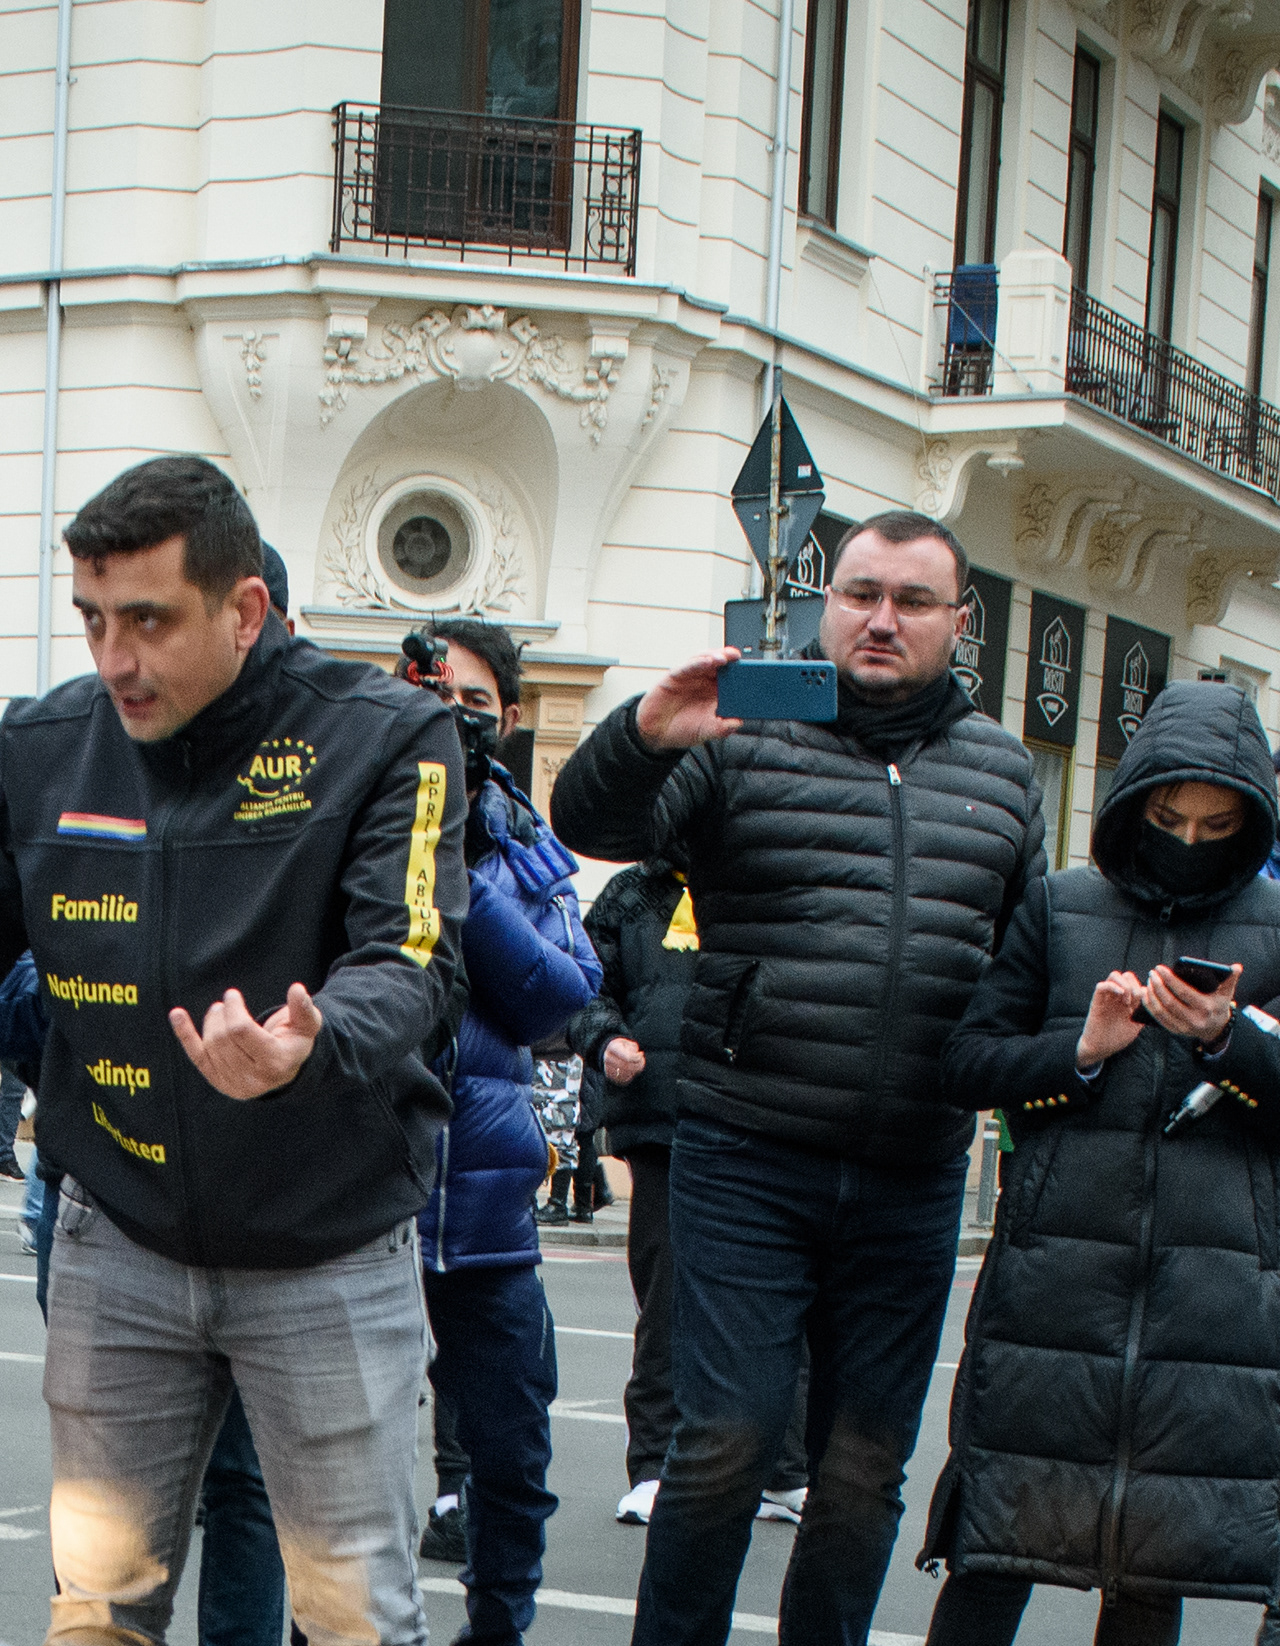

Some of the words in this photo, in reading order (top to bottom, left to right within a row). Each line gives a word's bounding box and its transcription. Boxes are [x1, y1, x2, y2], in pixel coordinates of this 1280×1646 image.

[1042, 666, 1066, 694] ROSTI
[249, 754, 302, 780] AUR
[51, 893, 138, 922] Familia
[85, 1058, 150, 1096] dința
